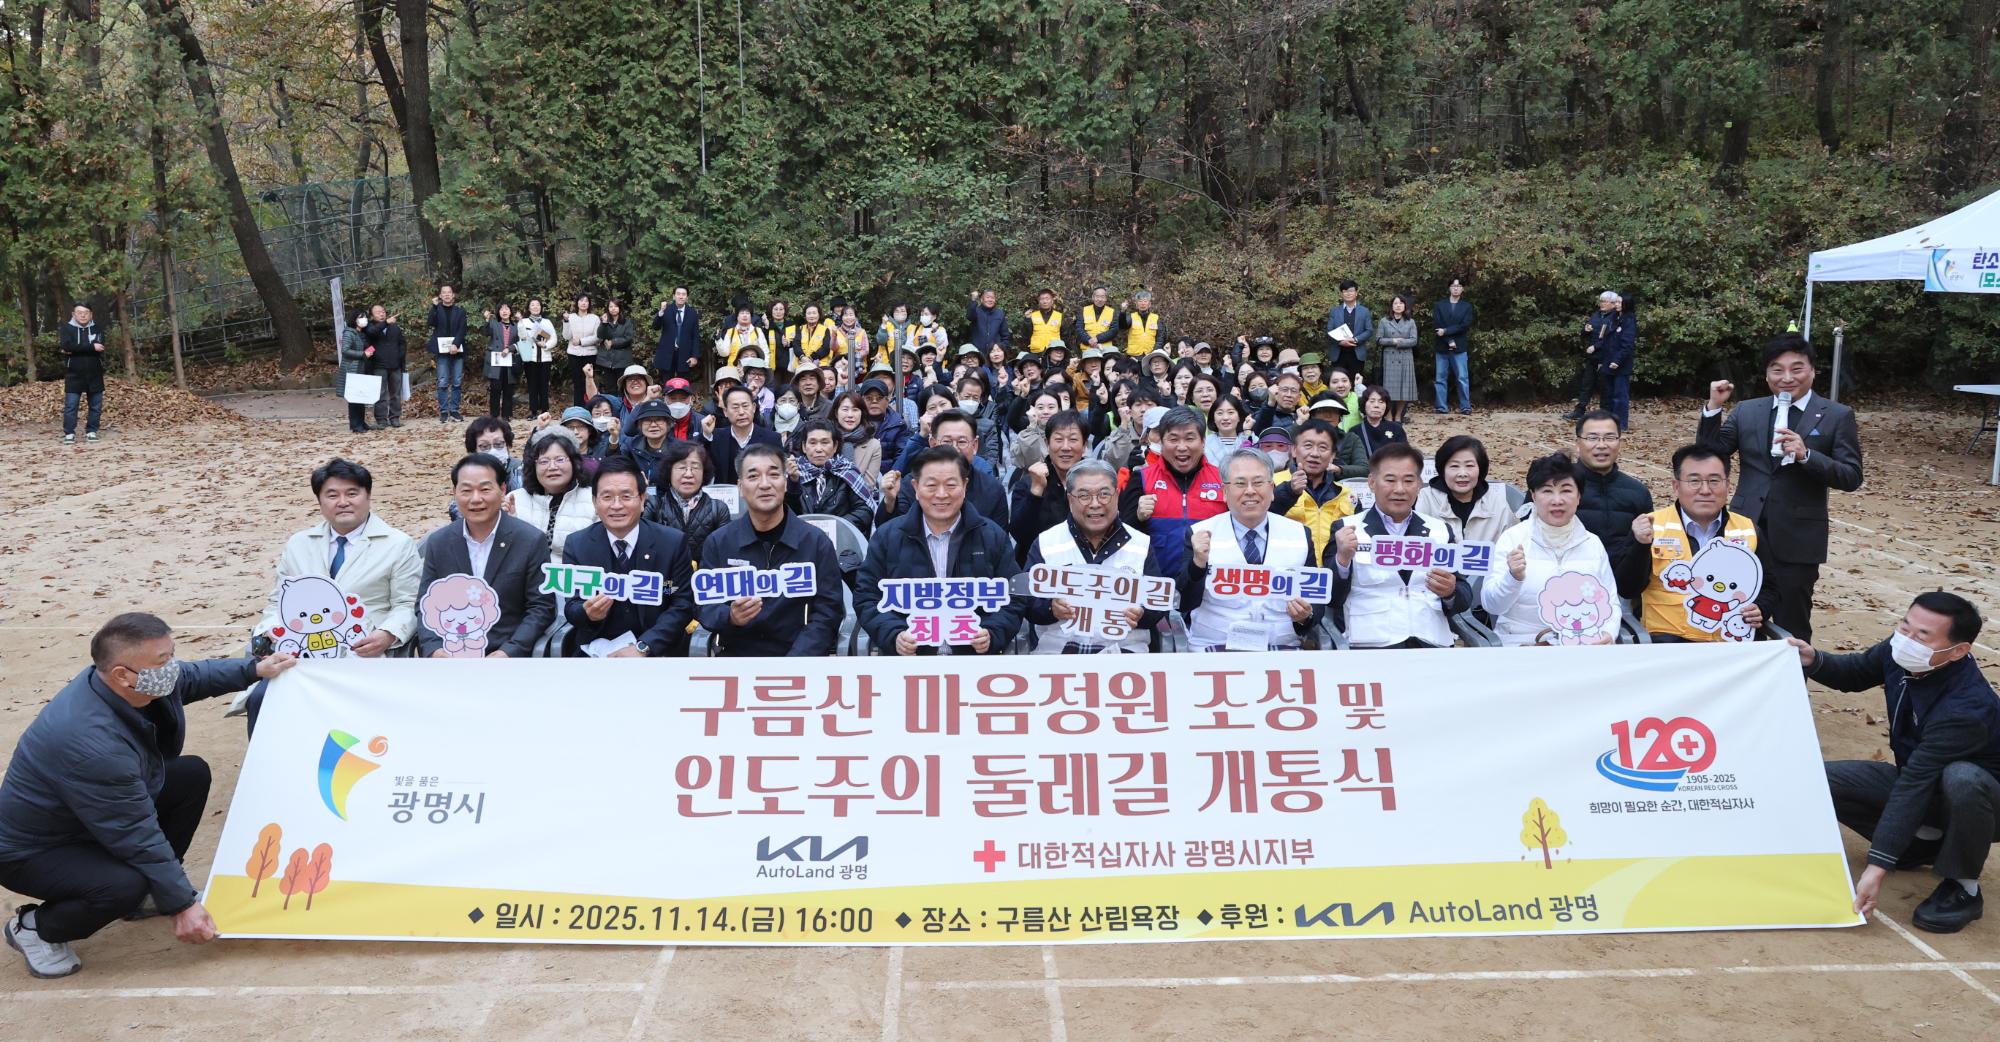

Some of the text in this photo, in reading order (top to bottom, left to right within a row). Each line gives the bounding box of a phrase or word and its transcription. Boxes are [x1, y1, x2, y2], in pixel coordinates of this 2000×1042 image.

[1972, 252, 1999, 269] 탄소
[1375, 539, 1490, 571] 평화의 길
[543, 567, 660, 602] 지구의 길
[695, 566, 813, 601] 연대의 길
[882, 582, 1006, 609] 지방정부
[1033, 568, 1172, 606] 인도주의 길
[1212, 568, 1328, 600] 생명의 길
[680, 669, 1386, 736] 구름산 마음정원 조성 및
[1611, 716, 1717, 774] 120
[395, 776, 439, 787] 빛을 품은
[675, 748, 1396, 817] 인도주의 둘레길 개통식
[388, 791, 485, 824] 광명시
[1589, 798, 1755, 814] 희망이 필요한 순간, 대한적십자사
[756, 836, 869, 862] KIA
[1018, 838, 1315, 869] 대한적십자사 광명시지부
[756, 864, 868, 880] AutoLand 광명
[568, 905, 786, 933] 2025.11.14.(금)
[796, 907, 873, 933] 16:00
[997, 907, 1072, 932] 구름산
[1079, 905, 1180, 932] 산림욕장
[1294, 901, 1395, 927] KIA
[1408, 898, 1543, 924] AutoLand
[1549, 894, 1600, 922] 광명
